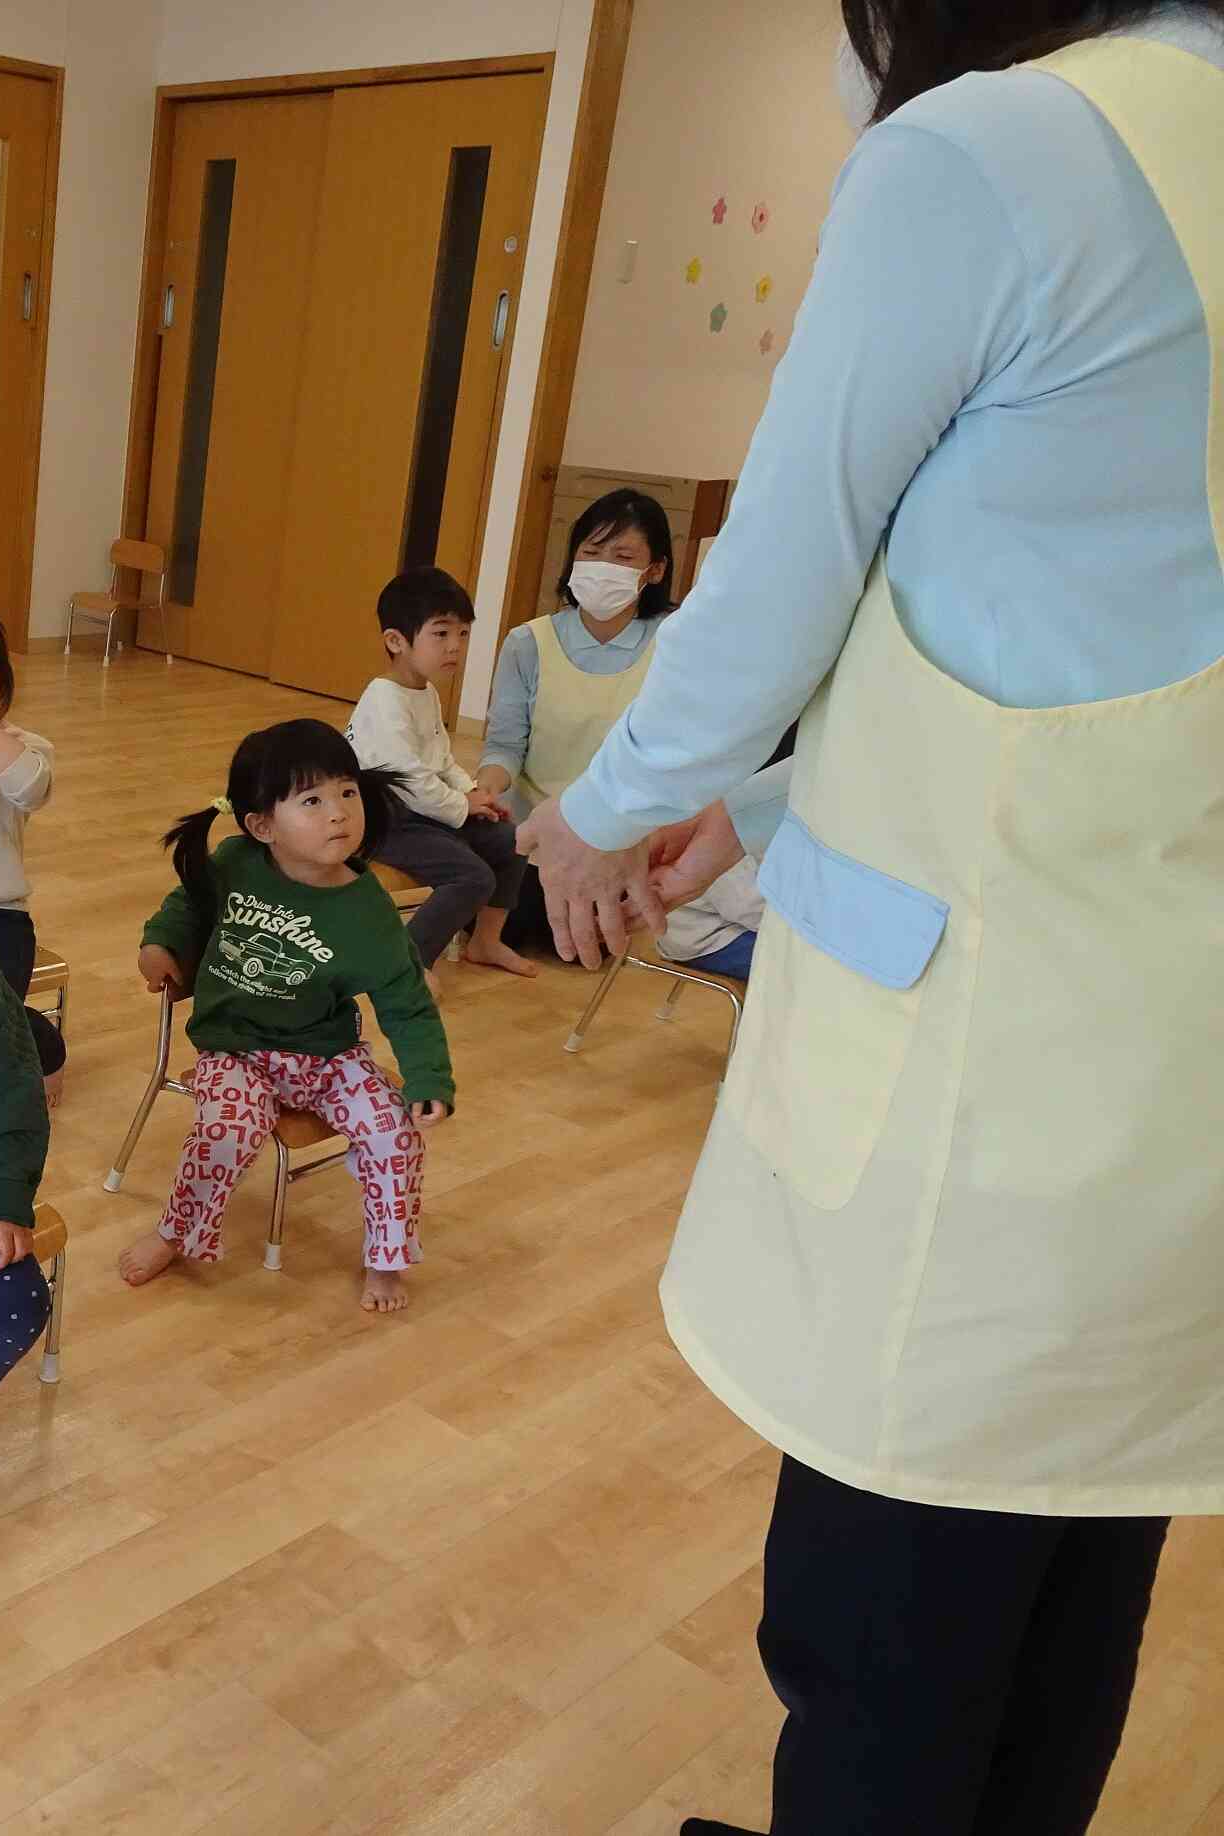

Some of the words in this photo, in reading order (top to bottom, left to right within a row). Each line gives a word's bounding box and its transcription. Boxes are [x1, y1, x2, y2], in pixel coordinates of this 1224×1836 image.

[223, 892, 334, 963] Sunshine
[244, 895, 273, 912] Drive
[272, 904, 295, 920] Into
